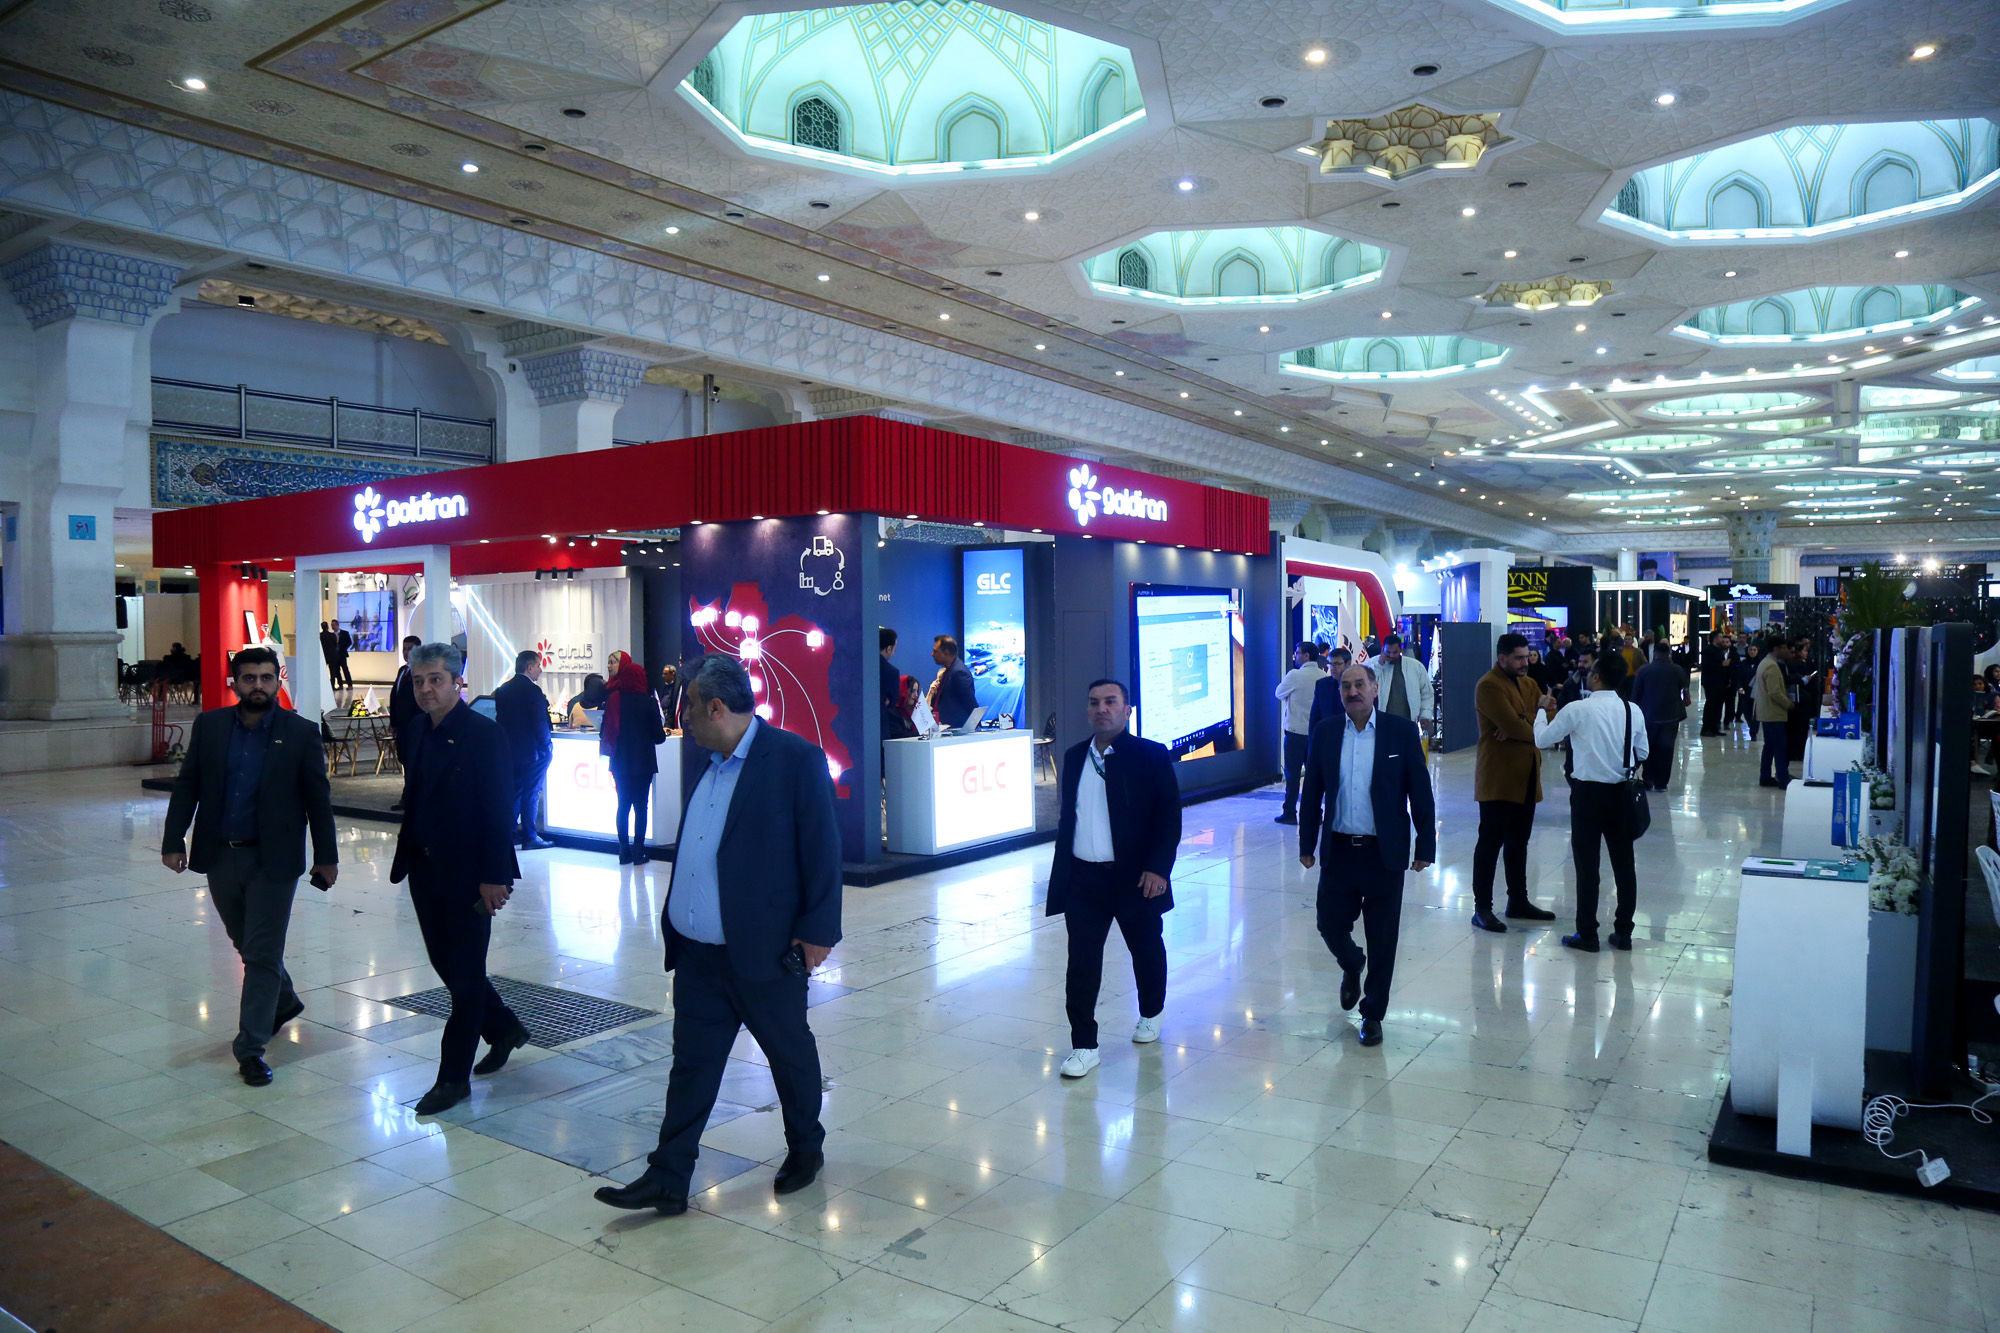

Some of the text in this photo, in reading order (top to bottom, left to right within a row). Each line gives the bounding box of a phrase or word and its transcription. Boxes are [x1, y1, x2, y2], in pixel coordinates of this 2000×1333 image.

[386, 491, 468, 527] goldiran
[1102, 486, 1168, 522] goldiran
[976, 572, 1012, 590] GLC
[962, 761, 1007, 794] GLC
